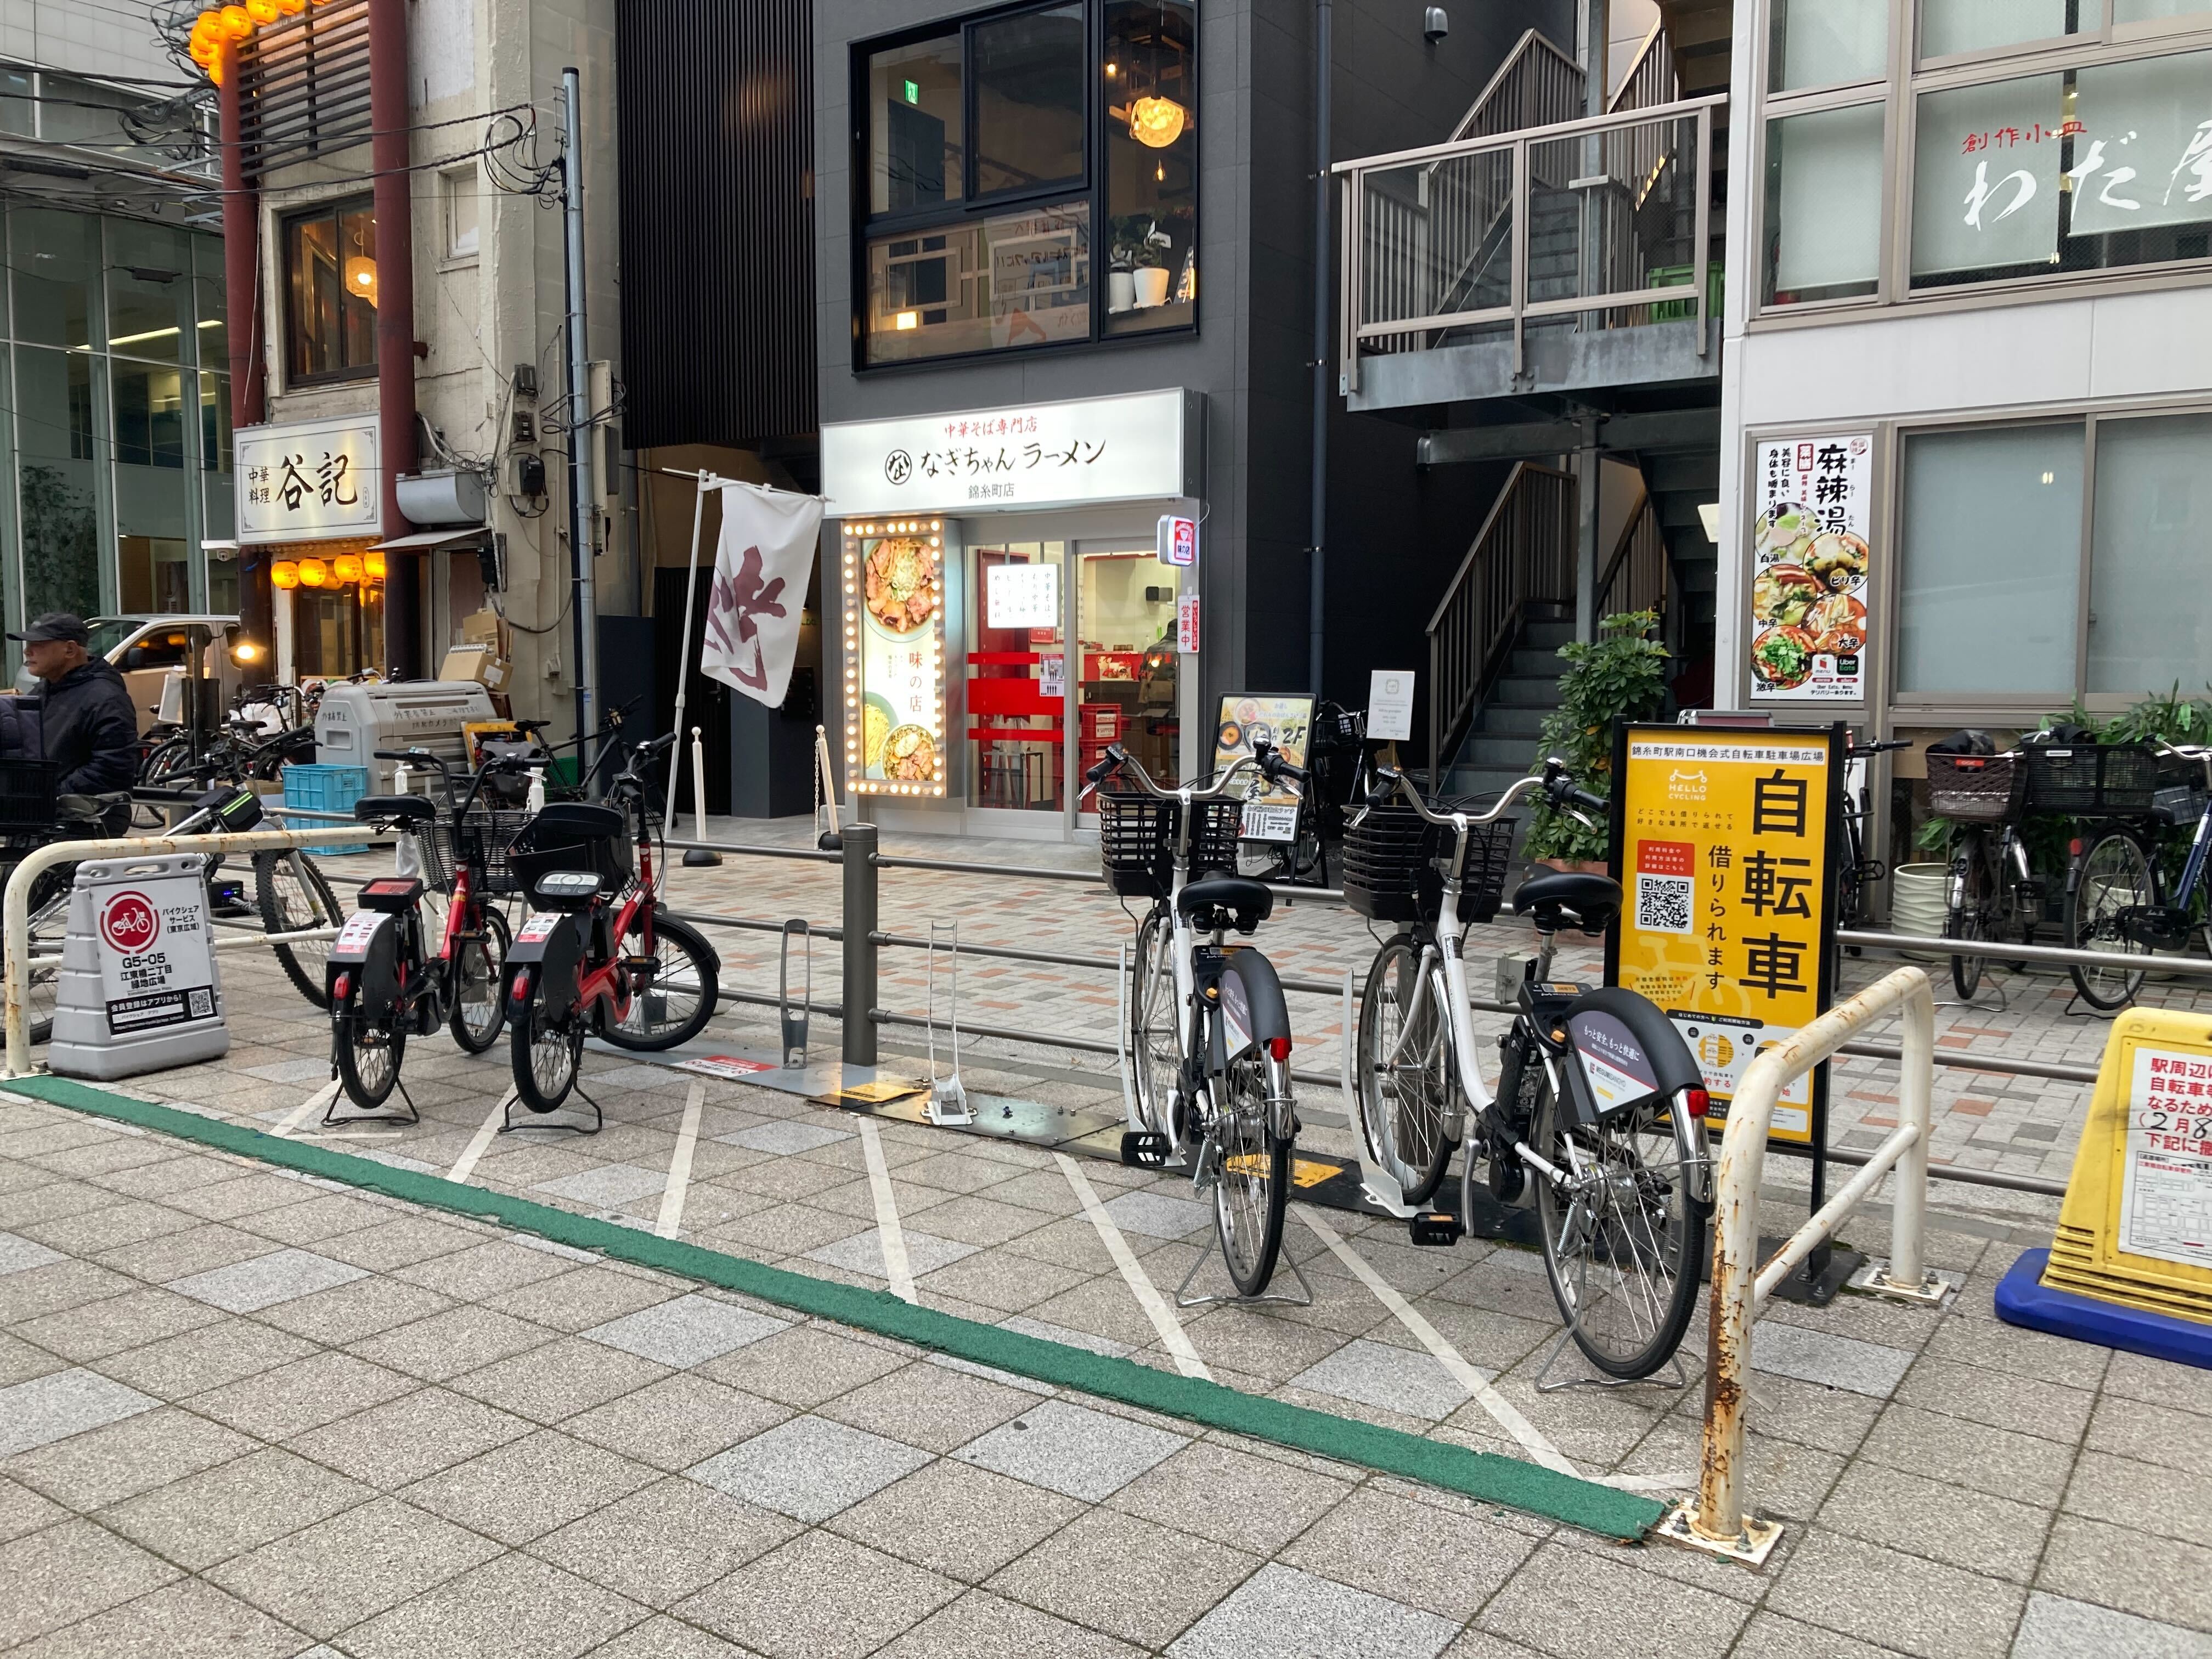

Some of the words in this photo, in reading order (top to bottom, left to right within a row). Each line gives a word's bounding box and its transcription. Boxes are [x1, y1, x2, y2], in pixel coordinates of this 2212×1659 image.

[1962, 121, 2087, 155] 創作小皿
[945, 415, 1037, 438] 中華そば専門店
[248, 466, 269, 485] 中華
[276, 452, 358, 511] 谷記
[249, 488, 270, 505] 料理
[968, 483, 1014, 499] 錦糸町店
[1815, 444, 1848, 536] 麻辣湯
[1181, 605, 1190, 646] 営業中
[909, 651, 923, 712] 味の店
[1283, 726, 1306, 746] 2F
[1669, 785, 1707, 793] HELLO
[1638, 808, 1733, 820] どこでも借りられて
[1740, 769, 1812, 1000] 自転車
[163, 905, 199, 916] バイクシェア
[169, 915, 195, 923] サービス
[1706, 845, 1733, 991] 借りられます
[122, 952, 166, 969] G5-05
